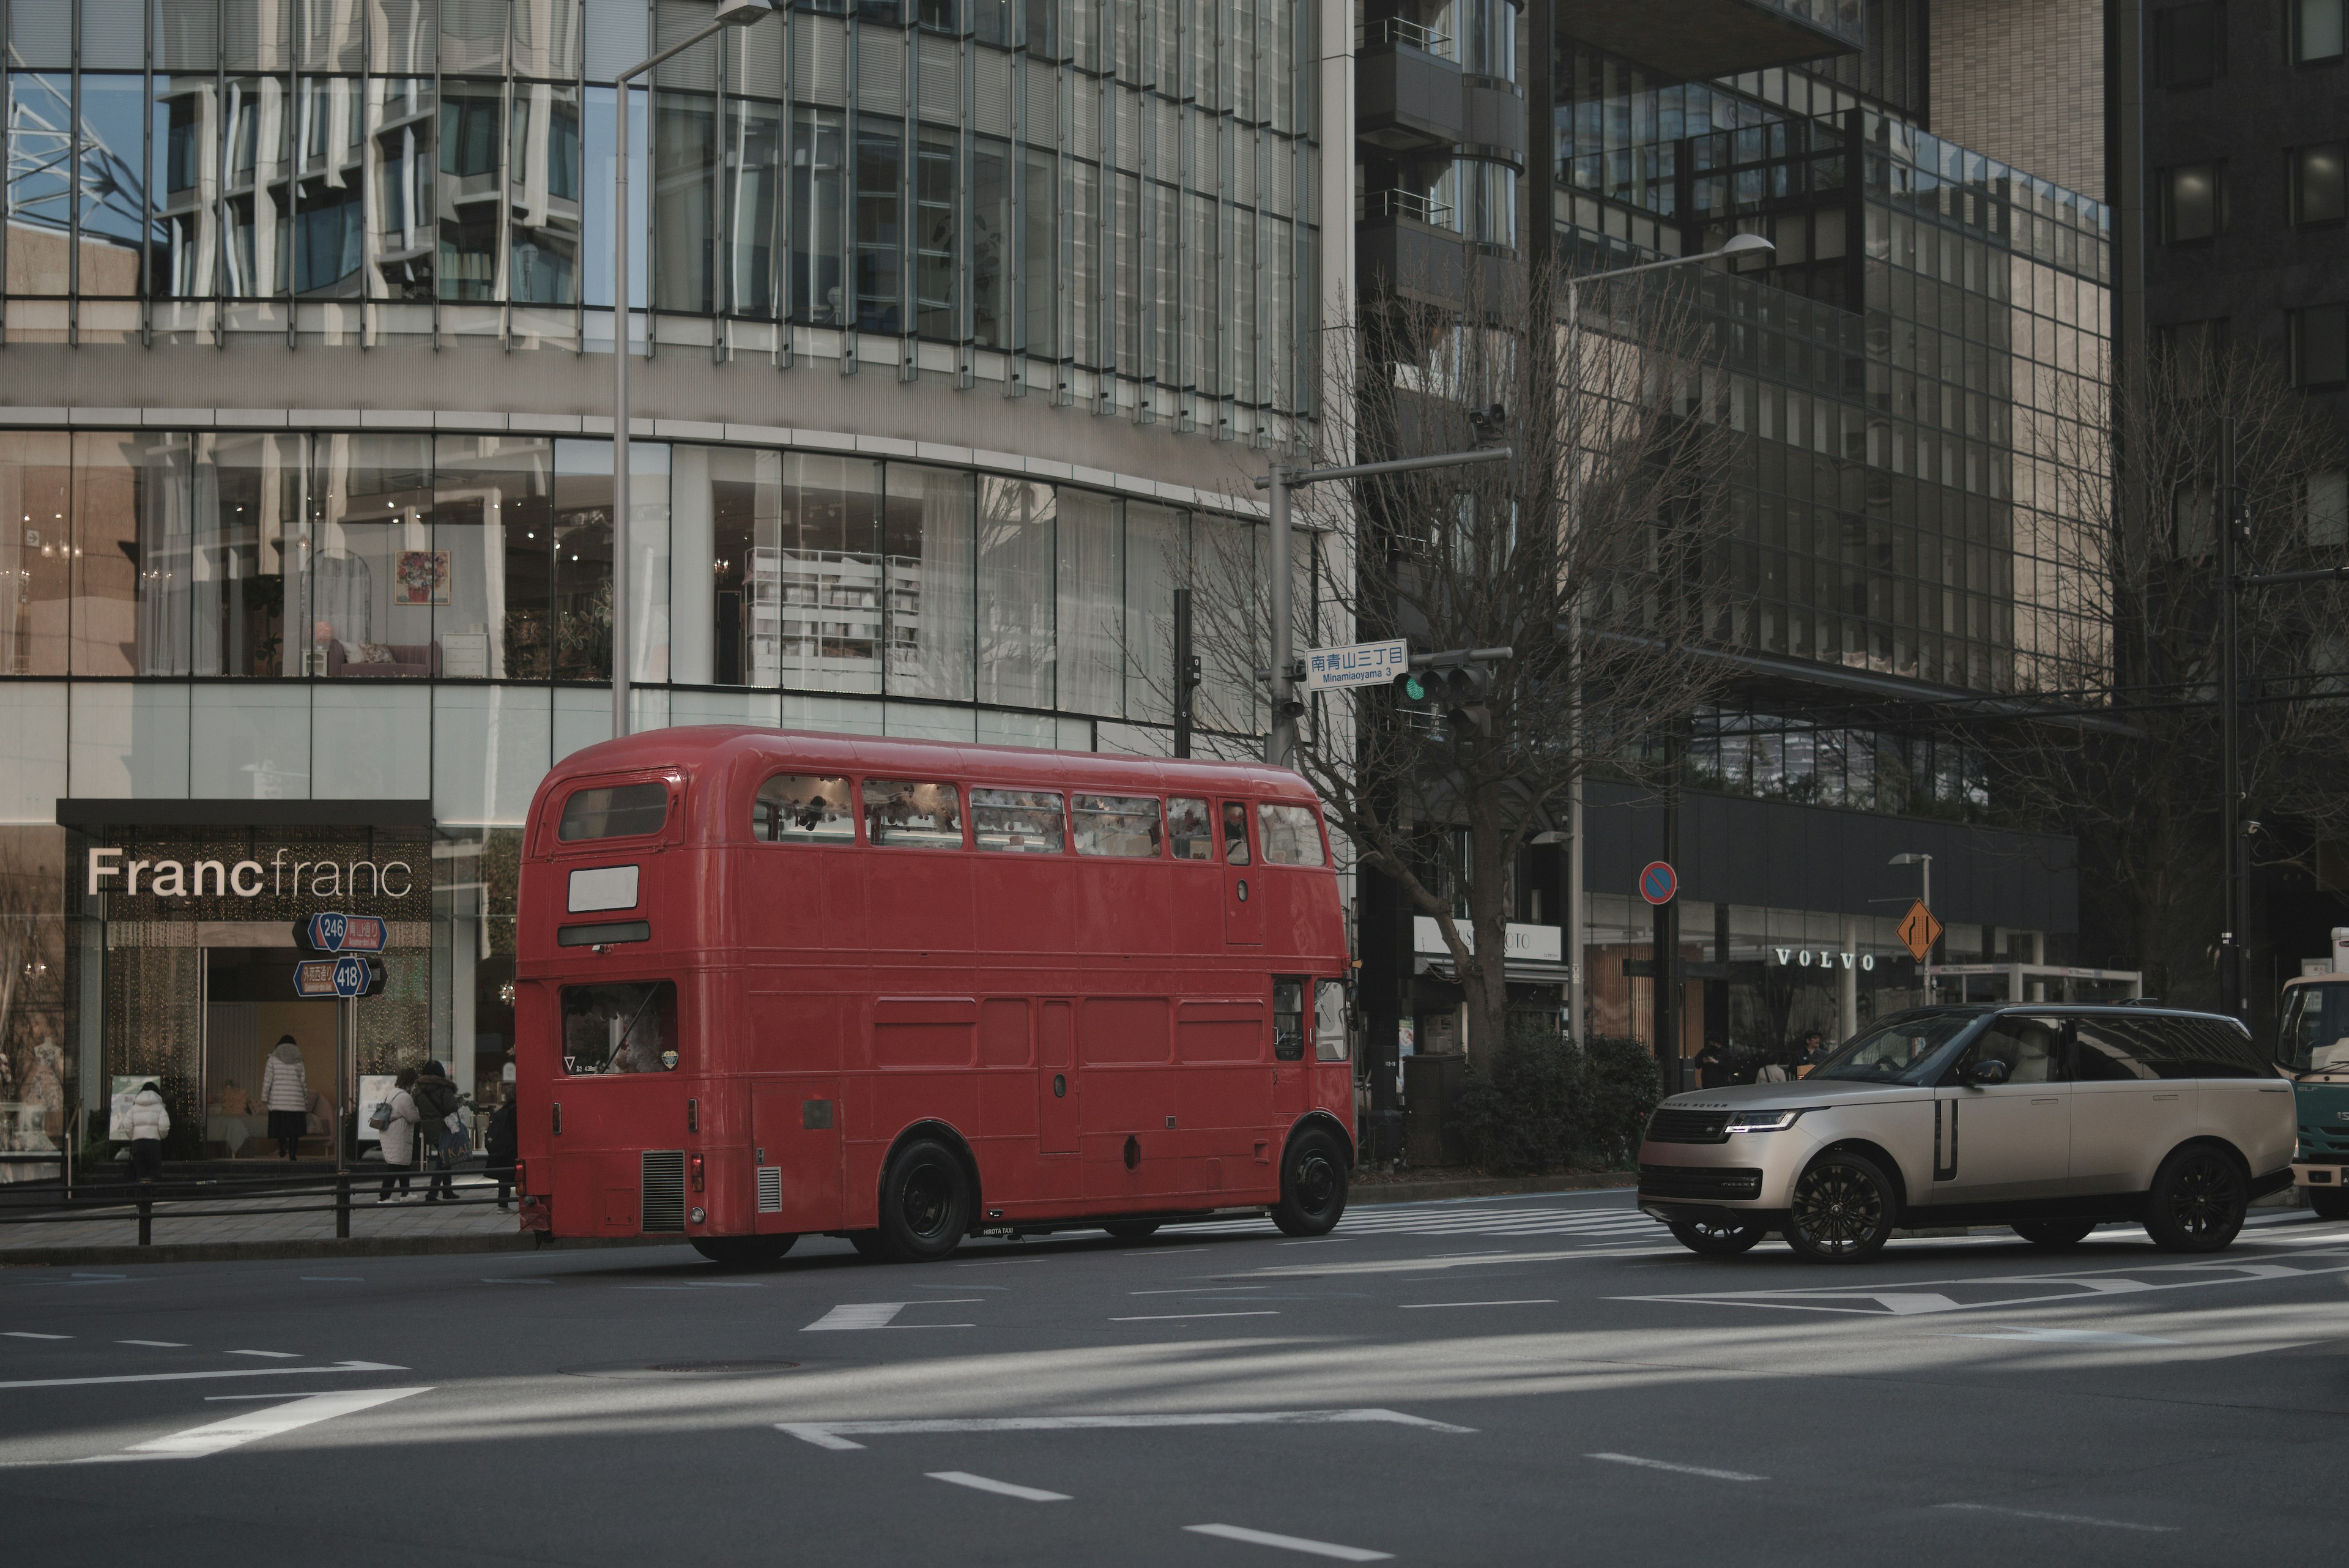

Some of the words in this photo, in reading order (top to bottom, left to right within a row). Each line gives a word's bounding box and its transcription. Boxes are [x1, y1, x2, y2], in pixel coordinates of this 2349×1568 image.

[1311, 647, 1402, 672] 南青山三丁目
[1323, 670, 1382, 683] Minamiaoyama
[1386, 667, 1392, 676] 3
[88, 847, 412, 897] Francfranc
[324, 918, 343, 937] 246
[349, 921, 378, 937] 青山通り
[1775, 948, 1874, 971] VOLVO
[303, 965, 332, 981] 外苑西通り
[337, 966, 357, 987] 418
